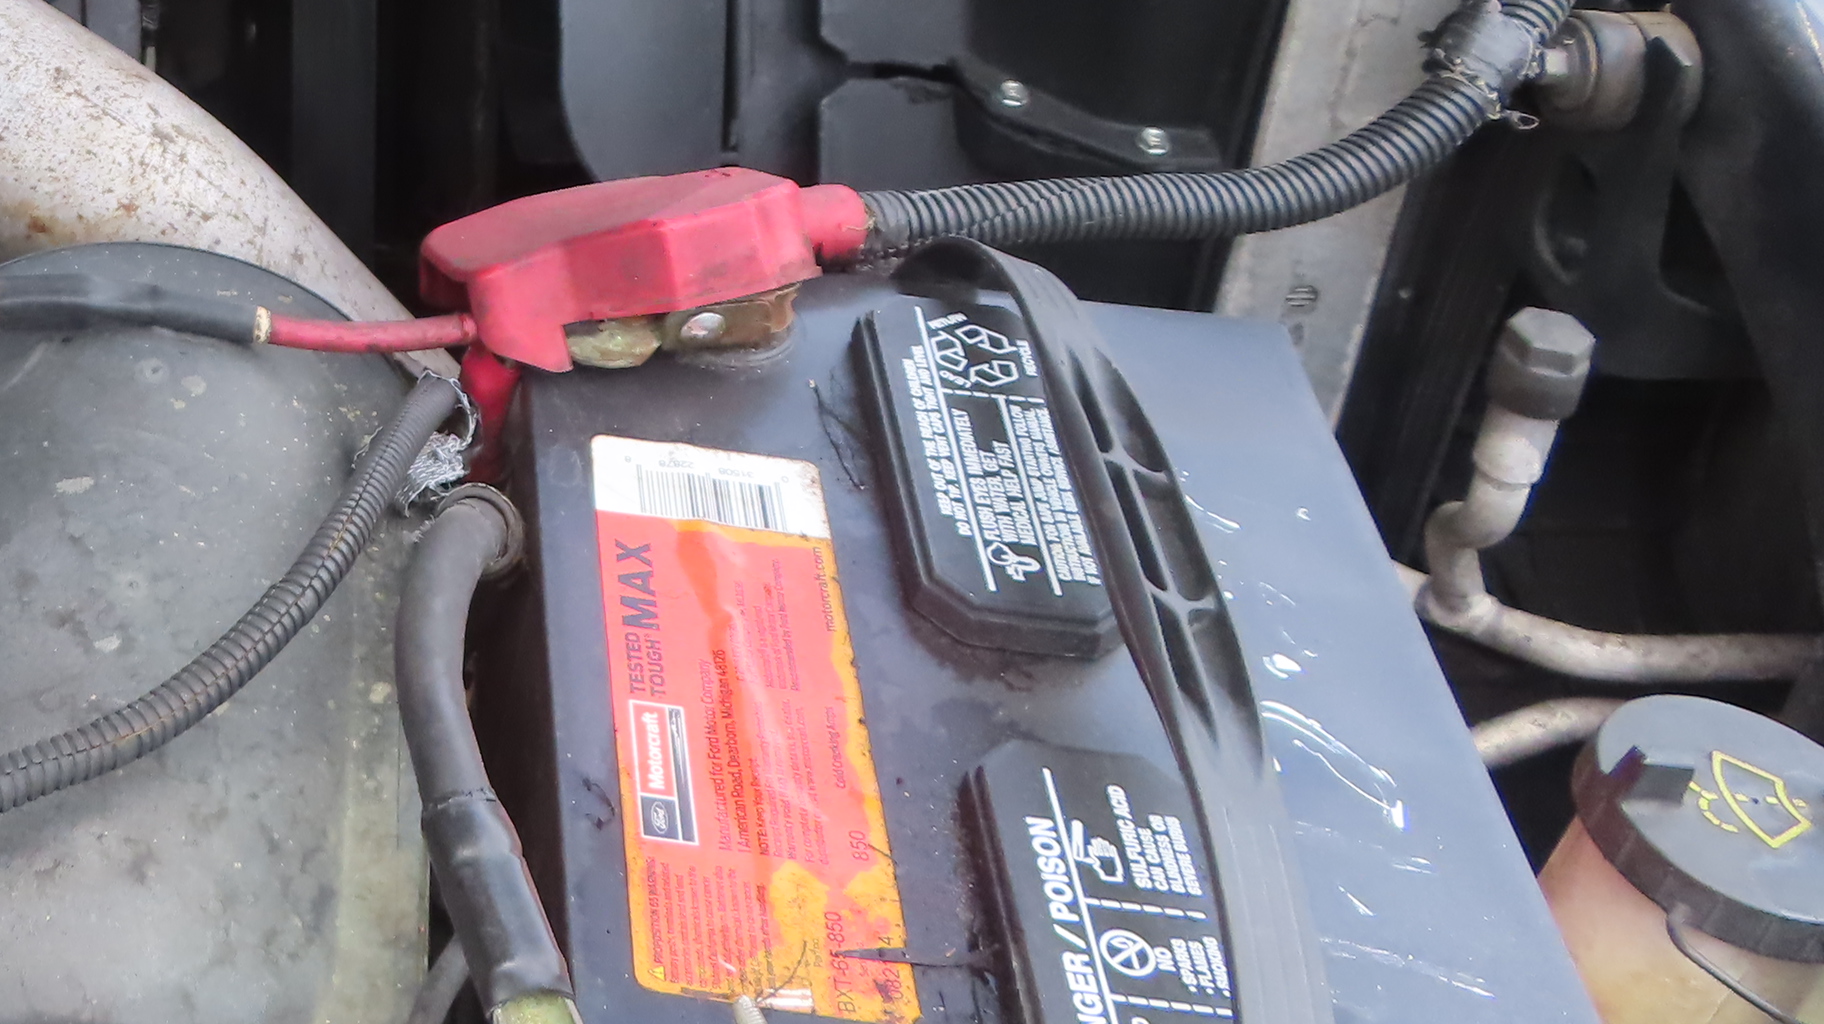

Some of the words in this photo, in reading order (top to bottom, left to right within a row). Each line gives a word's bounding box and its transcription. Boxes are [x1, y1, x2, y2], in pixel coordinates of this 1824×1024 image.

[1016, 340, 1038, 376] RECYCLE
[902, 358, 923, 396] CHILDREN
[916, 368, 932, 385] AND
[912, 398, 926, 410] OF
[922, 386, 939, 410] TIGHT
[916, 410, 934, 438] REACH
[928, 412, 945, 433] CAPS
[1010, 404, 1028, 436] FOLLOW
[922, 440, 939, 456] THE
[934, 434, 950, 457] VENT
[950, 408, 984, 475] IMMEDIATELY
[992, 440, 1014, 467] FAST
[926, 458, 942, 471] OF
[940, 458, 957, 480] KEEP
[978, 450, 999, 472] GET
[930, 472, 947, 490] OUT
[968, 478, 991, 504] EYES
[1000, 468, 1023, 498] HELP
[936, 492, 954, 516] KEEP
[950, 500, 968, 520] NOT
[956, 522, 972, 535] DO
[976, 506, 1001, 540] FLUSH
[996, 514, 1019, 542] WITH
[1010, 500, 1037, 544] MEDICAL
[614, 538, 659, 631] MAX
[809, 545, 836, 632] motorcraft.com
[624, 630, 646, 694] TESTED
[711, 647, 729, 676] 48126
[696, 658, 716, 705] Company
[715, 676, 736, 720] Michigan
[702, 704, 718, 735] Motor
[640, 709, 665, 790] Motorcraft
[705, 736, 721, 760] Ford
[722, 719, 742, 768] Dearborn,
[826, 730, 845, 768] Cranking
[707, 761, 723, 776] for
[727, 767, 746, 798] Road,
[832, 768, 847, 789] Cold
[750, 787, 763, 805] Your
[778, 798, 792, 818] void
[1108, 786, 1132, 820] ACID
[710, 777, 732, 851] Manufactured
[731, 798, 751, 847] American
[753, 806, 767, 828] Keep
[796, 806, 814, 848] complete
[1148, 814, 1166, 832] OR
[756, 829, 770, 856] NOTE:
[846, 828, 870, 861] 850
[1138, 828, 1161, 864] CAUSE
[1164, 816, 1188, 852] BURNS
[802, 847, 815, 863] For
[1116, 818, 1154, 888] SULFURIC
[1154, 834, 1186, 893] BLINDNESS
[1026, 816, 1080, 922] POISON
[1150, 866, 1170, 890] CAN
[1176, 852, 1202, 896] SEVERE
[648, 896, 659, 907] 65
[649, 908, 664, 964] PROPOSITION
[822, 910, 856, 1014] BXT-65-850
[1152, 946, 1176, 971] NO
